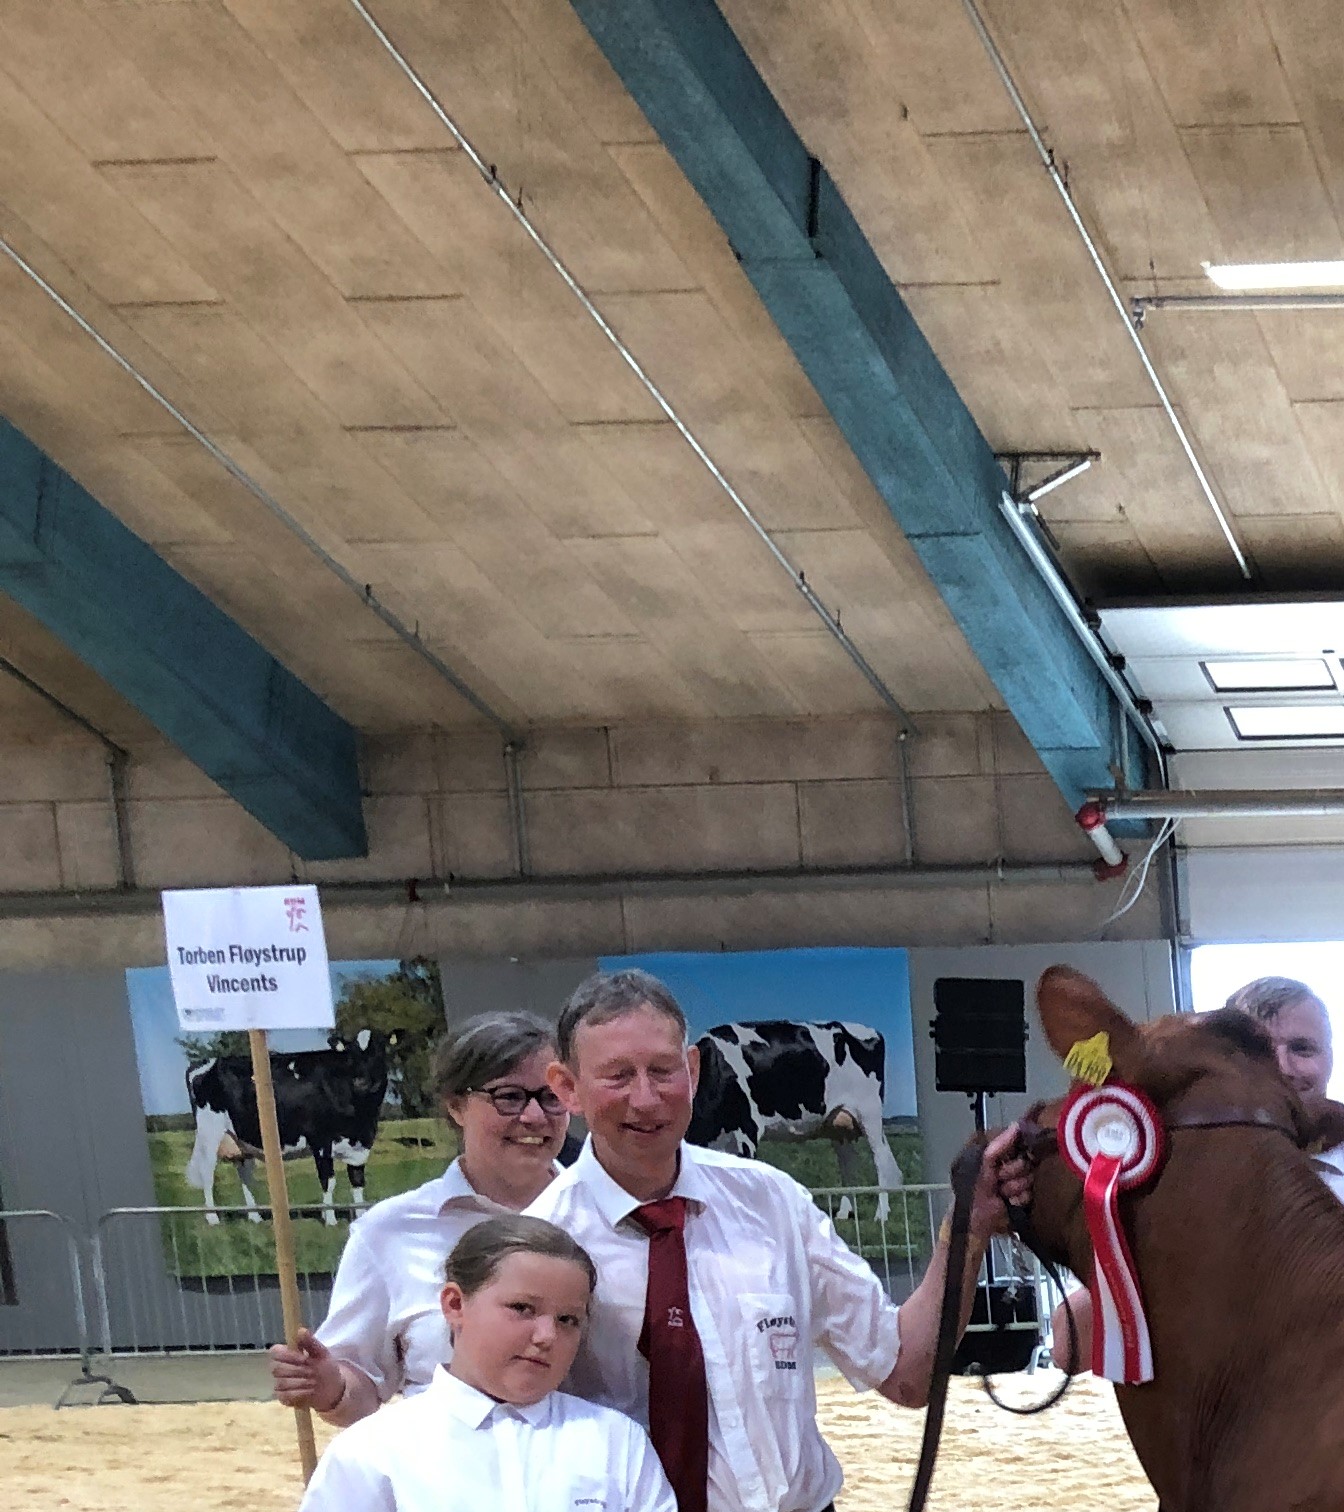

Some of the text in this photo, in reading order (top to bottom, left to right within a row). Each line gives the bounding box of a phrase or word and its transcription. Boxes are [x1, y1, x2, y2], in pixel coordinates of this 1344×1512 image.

[177, 944, 307, 967] Torben Fløystrup
[206, 974, 278, 993] Vincents
